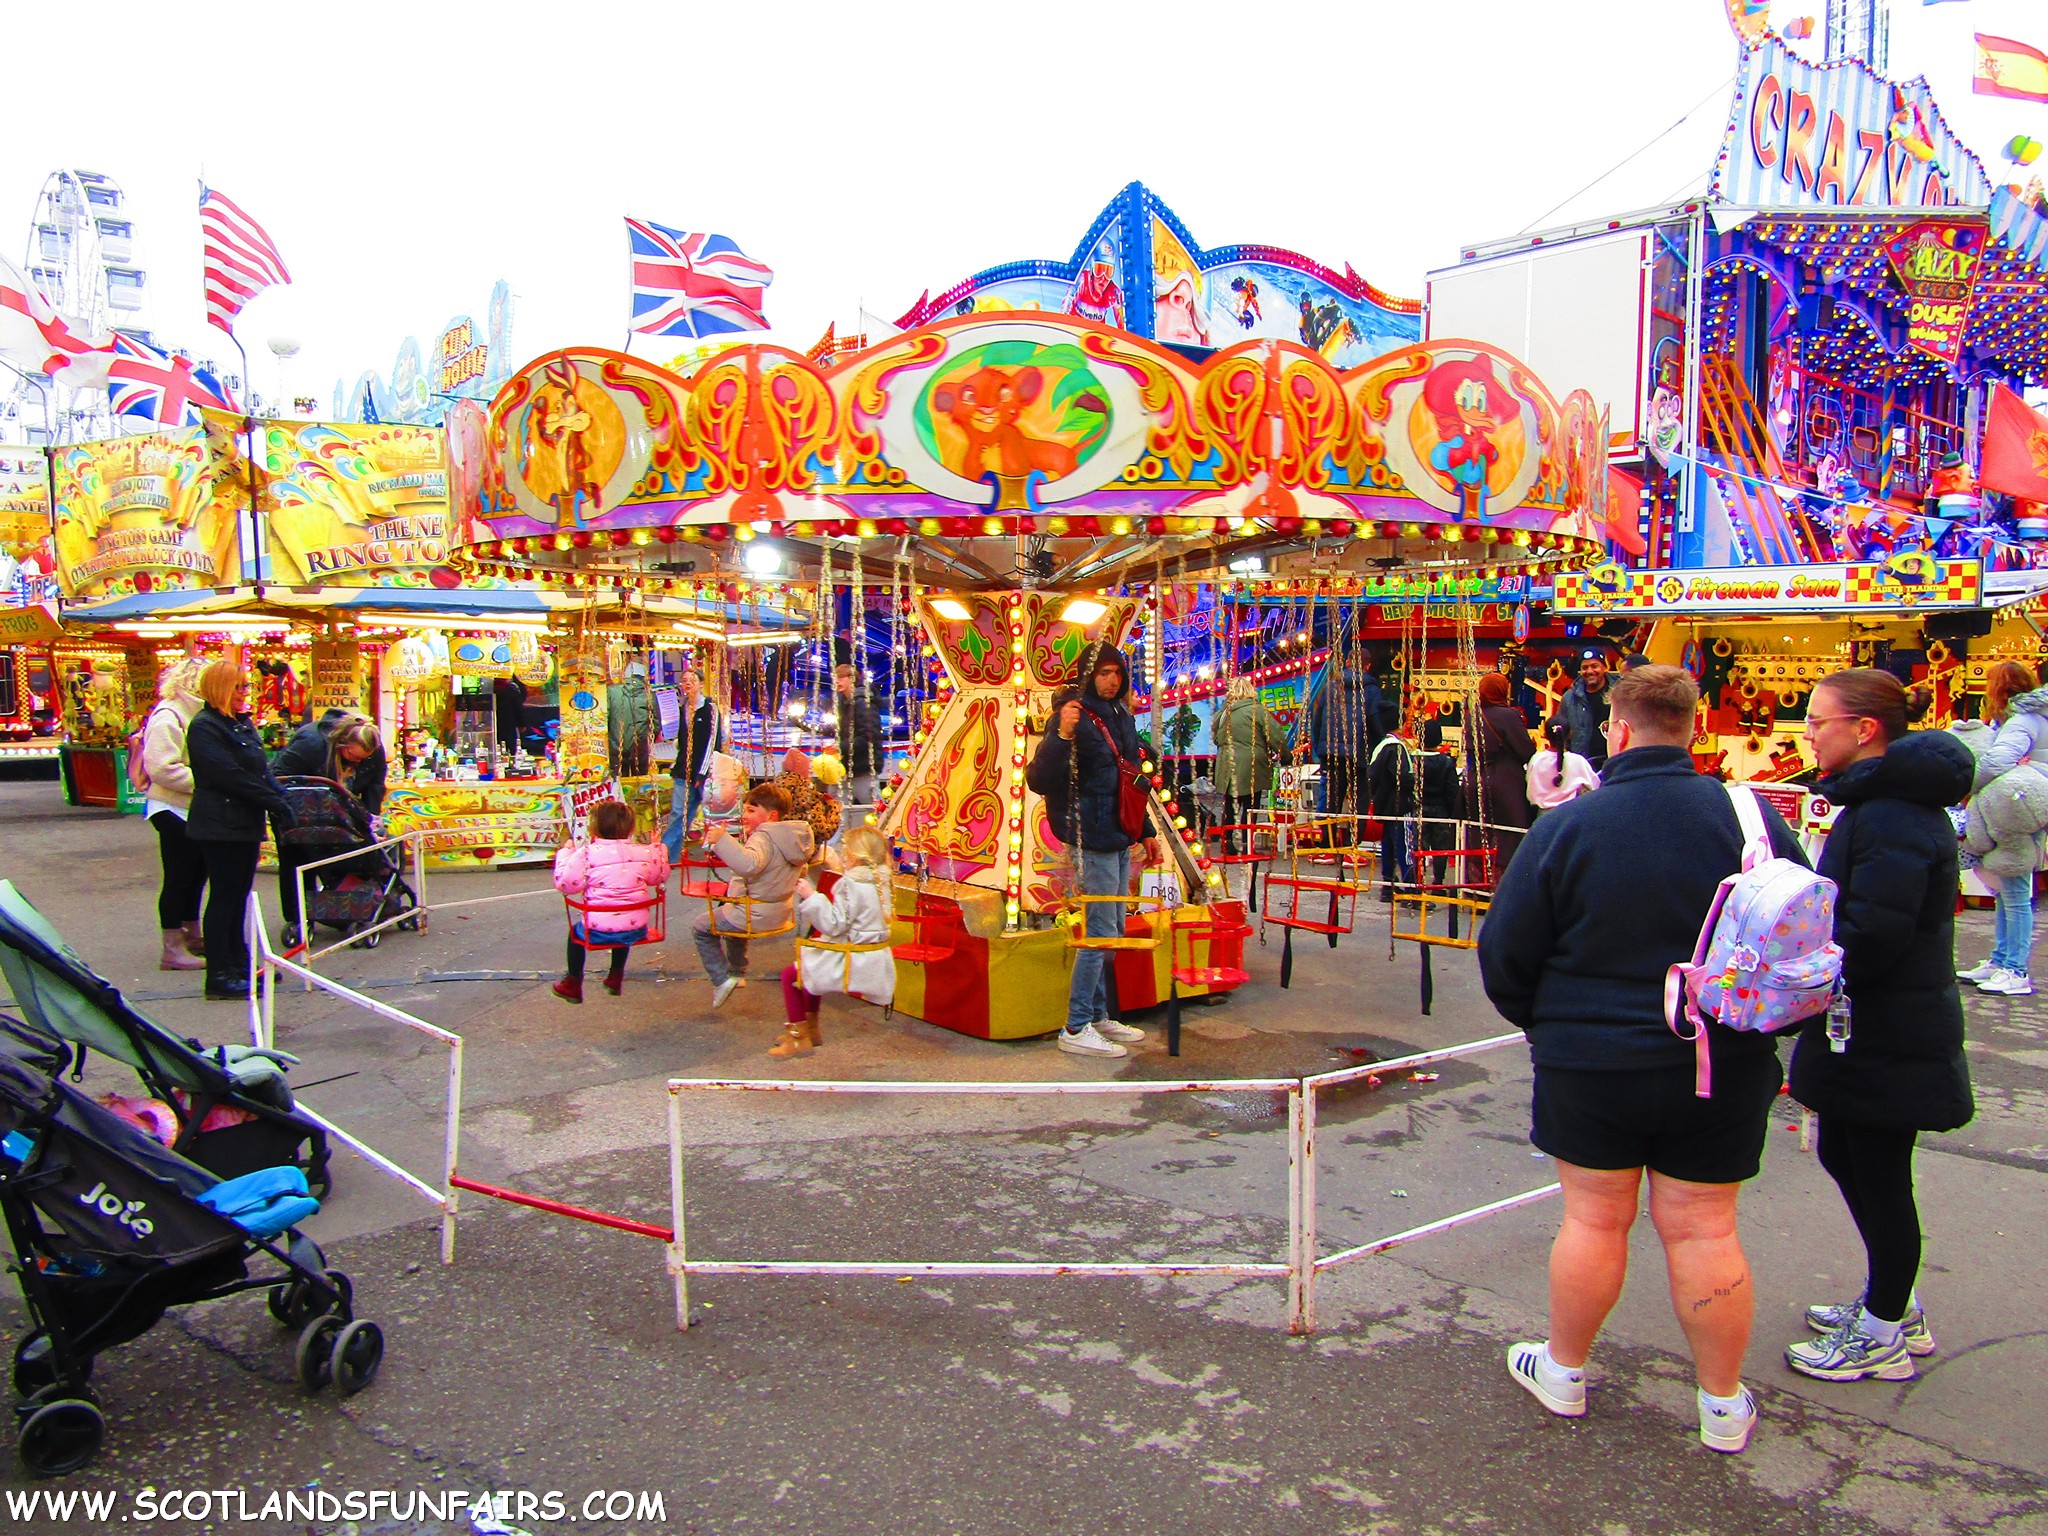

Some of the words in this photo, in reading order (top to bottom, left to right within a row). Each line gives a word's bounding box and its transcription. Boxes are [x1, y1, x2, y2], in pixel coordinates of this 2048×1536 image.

[368, 474, 423, 493] RICHARD
[149, 529, 185, 546] GAME
[370, 516, 413, 543] THE
[195, 551, 215, 573] WIN
[304, 542, 391, 575] RING
[396, 539, 446, 564] TO
[1251, 577, 1364, 598] DISASTER
[1366, 575, 1484, 597] BLASTER
[1497, 575, 1521, 591] £1
[1685, 576, 1781, 601] Fireman
[1784, 573, 1841, 599] Sam
[1870, 586, 1904, 595] CADETS
[1905, 584, 1950, 594] TRAINING
[318, 658, 353, 672] RING
[318, 671, 354, 684] OVER
[321, 684, 351, 696] THE
[313, 695, 359, 708] BLOCK
[571, 781, 612, 806] HAPPY
[1813, 803, 1828, 813] £1
[441, 830, 495, 847] THE
[500, 831, 561, 845] FAIR
[80, 1181, 154, 1239] Joie
